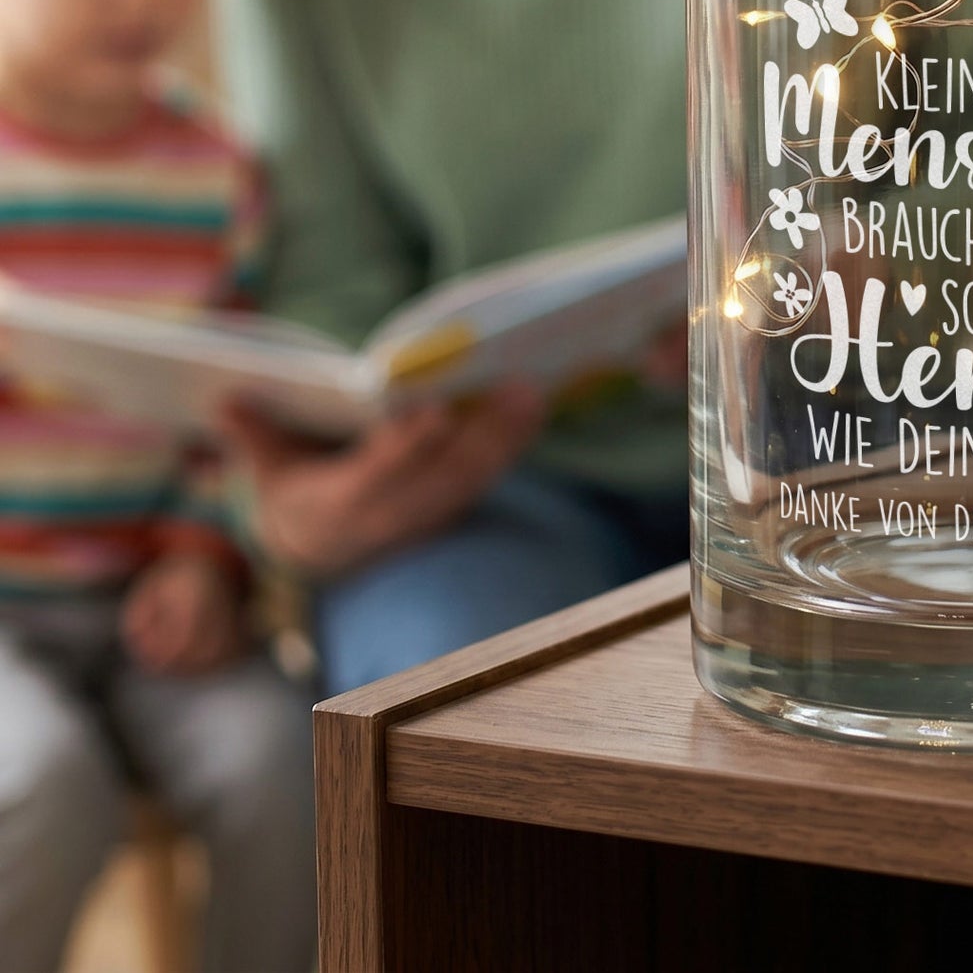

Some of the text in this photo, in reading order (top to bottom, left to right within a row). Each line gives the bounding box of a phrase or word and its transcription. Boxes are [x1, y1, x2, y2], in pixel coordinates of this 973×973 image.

[807, 404, 874, 467] WIE
[780, 482, 861, 533] DANKE
[879, 498, 937, 540] VON
